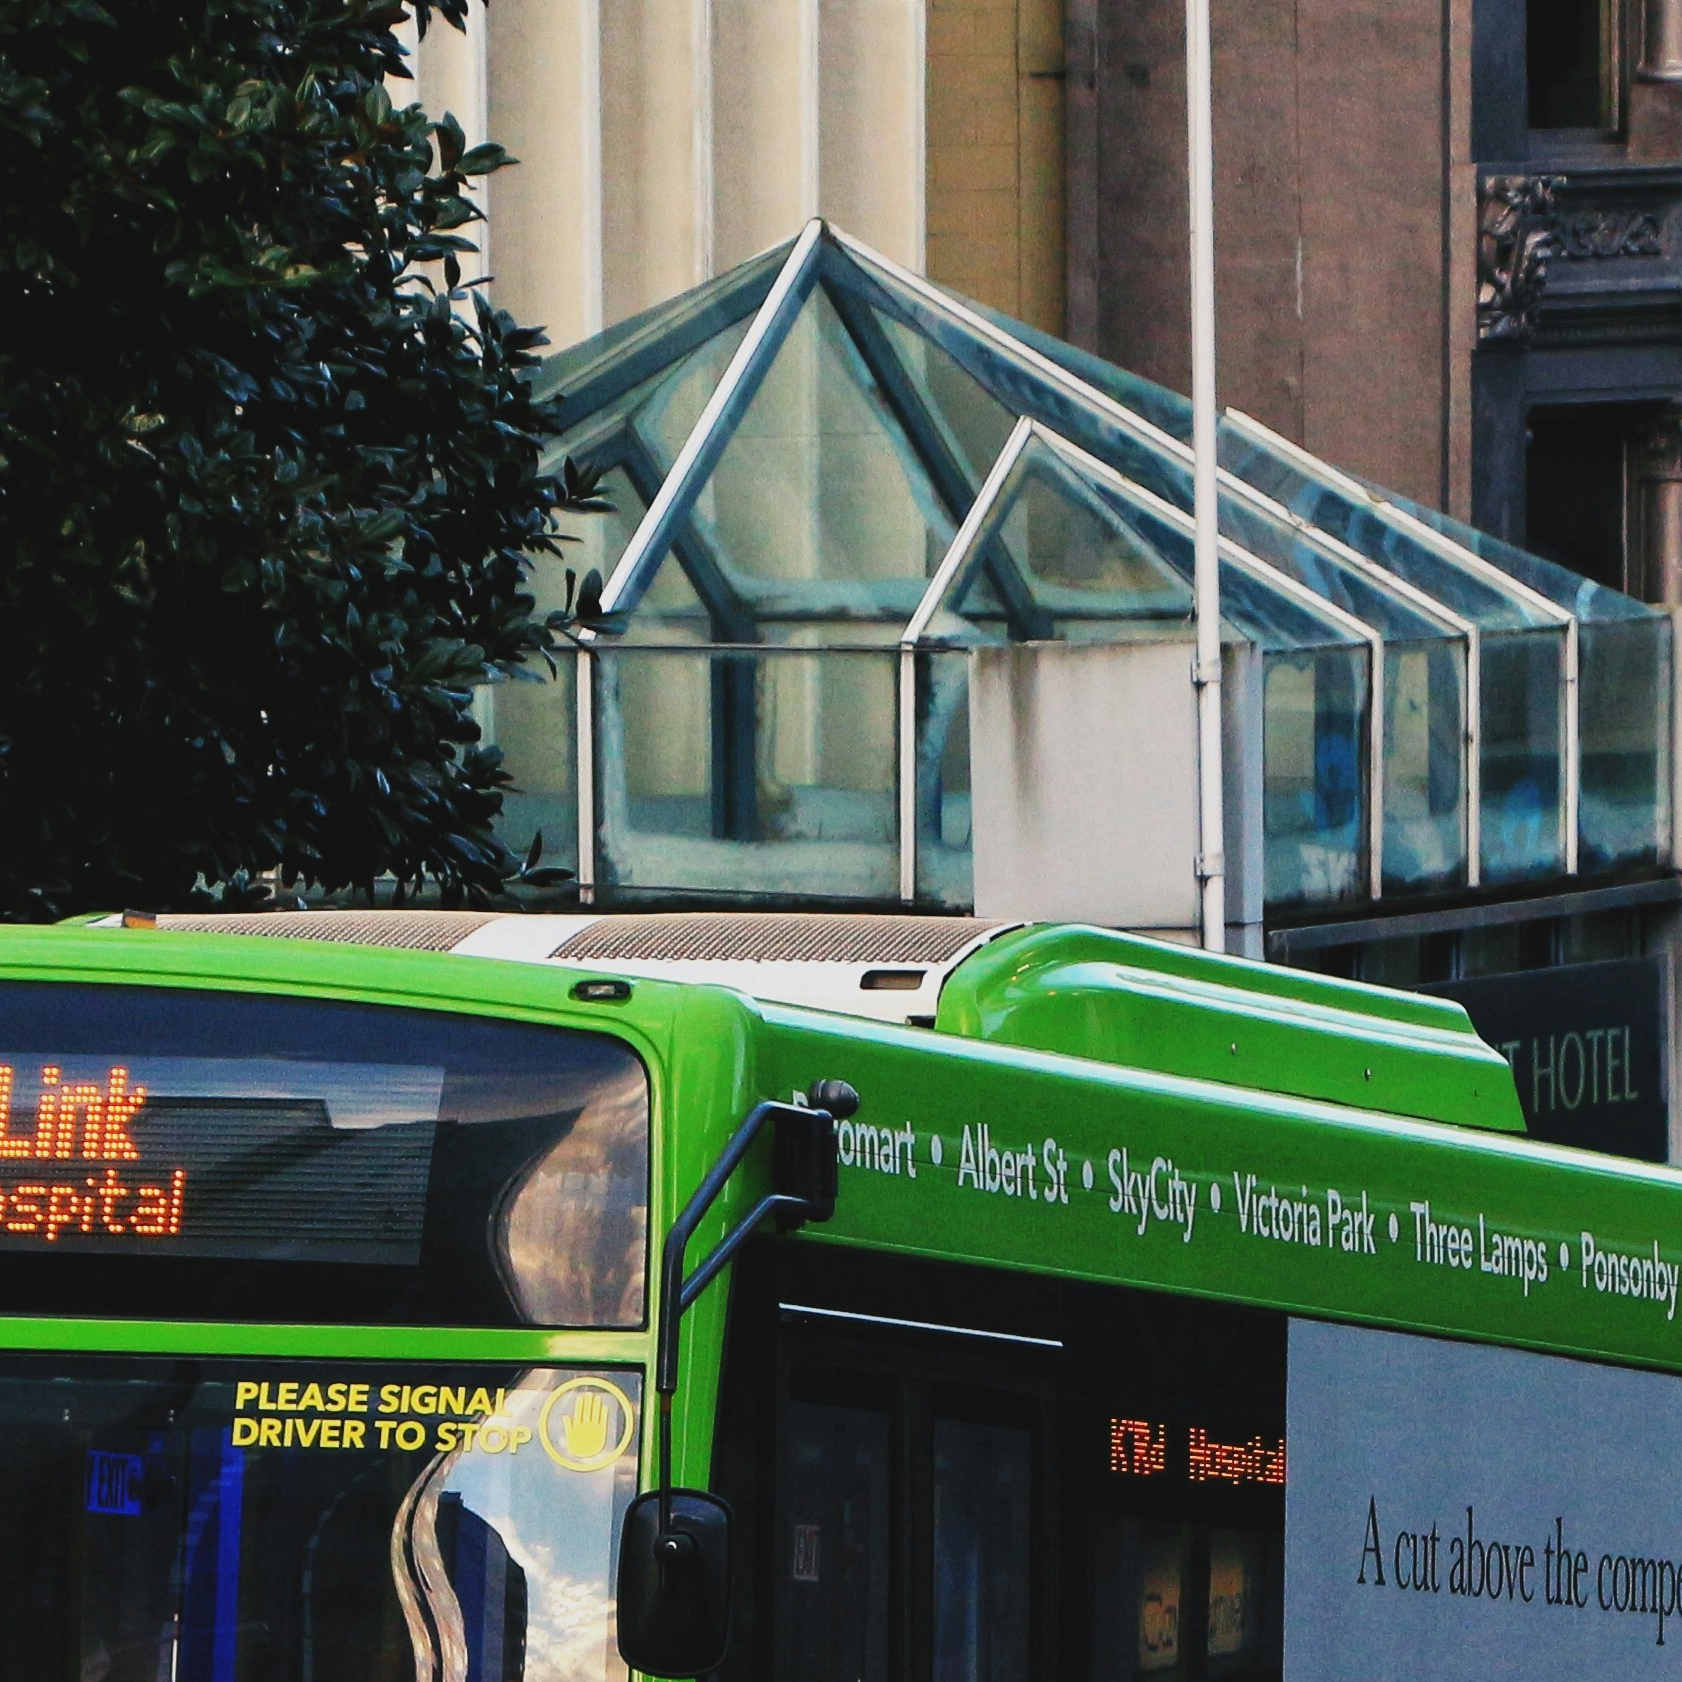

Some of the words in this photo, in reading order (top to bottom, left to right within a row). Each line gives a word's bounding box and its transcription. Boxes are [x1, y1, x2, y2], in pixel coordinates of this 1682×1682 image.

[1532, 1025, 1639, 1113] HOTEL
[958, 1122, 1038, 1200] Albert
[1043, 1137, 1068, 1205] St
[1107, 1147, 1197, 1243] SkyCity
[1233, 1171, 1321, 1246] Victoria
[1327, 1188, 1376, 1254] Park
[1409, 1200, 1473, 1269] Three
[1478, 1213, 1548, 1297] Lamps
[1580, 1231, 1678, 1321] Ponsonby
[234, 1381, 371, 1413] PLEASE
[378, 1384, 514, 1417] SIGNAL
[231, 1417, 365, 1448] DRIVER
[374, 1420, 426, 1451] TO
[435, 1422, 533, 1455] STOP
[1188, 1427, 1285, 1485] Hospital
[1357, 1494, 1386, 1587] A
[1394, 1520, 1440, 1593] cut
[1449, 1505, 1535, 1603] above
[1544, 1516, 1588, 1608] the
